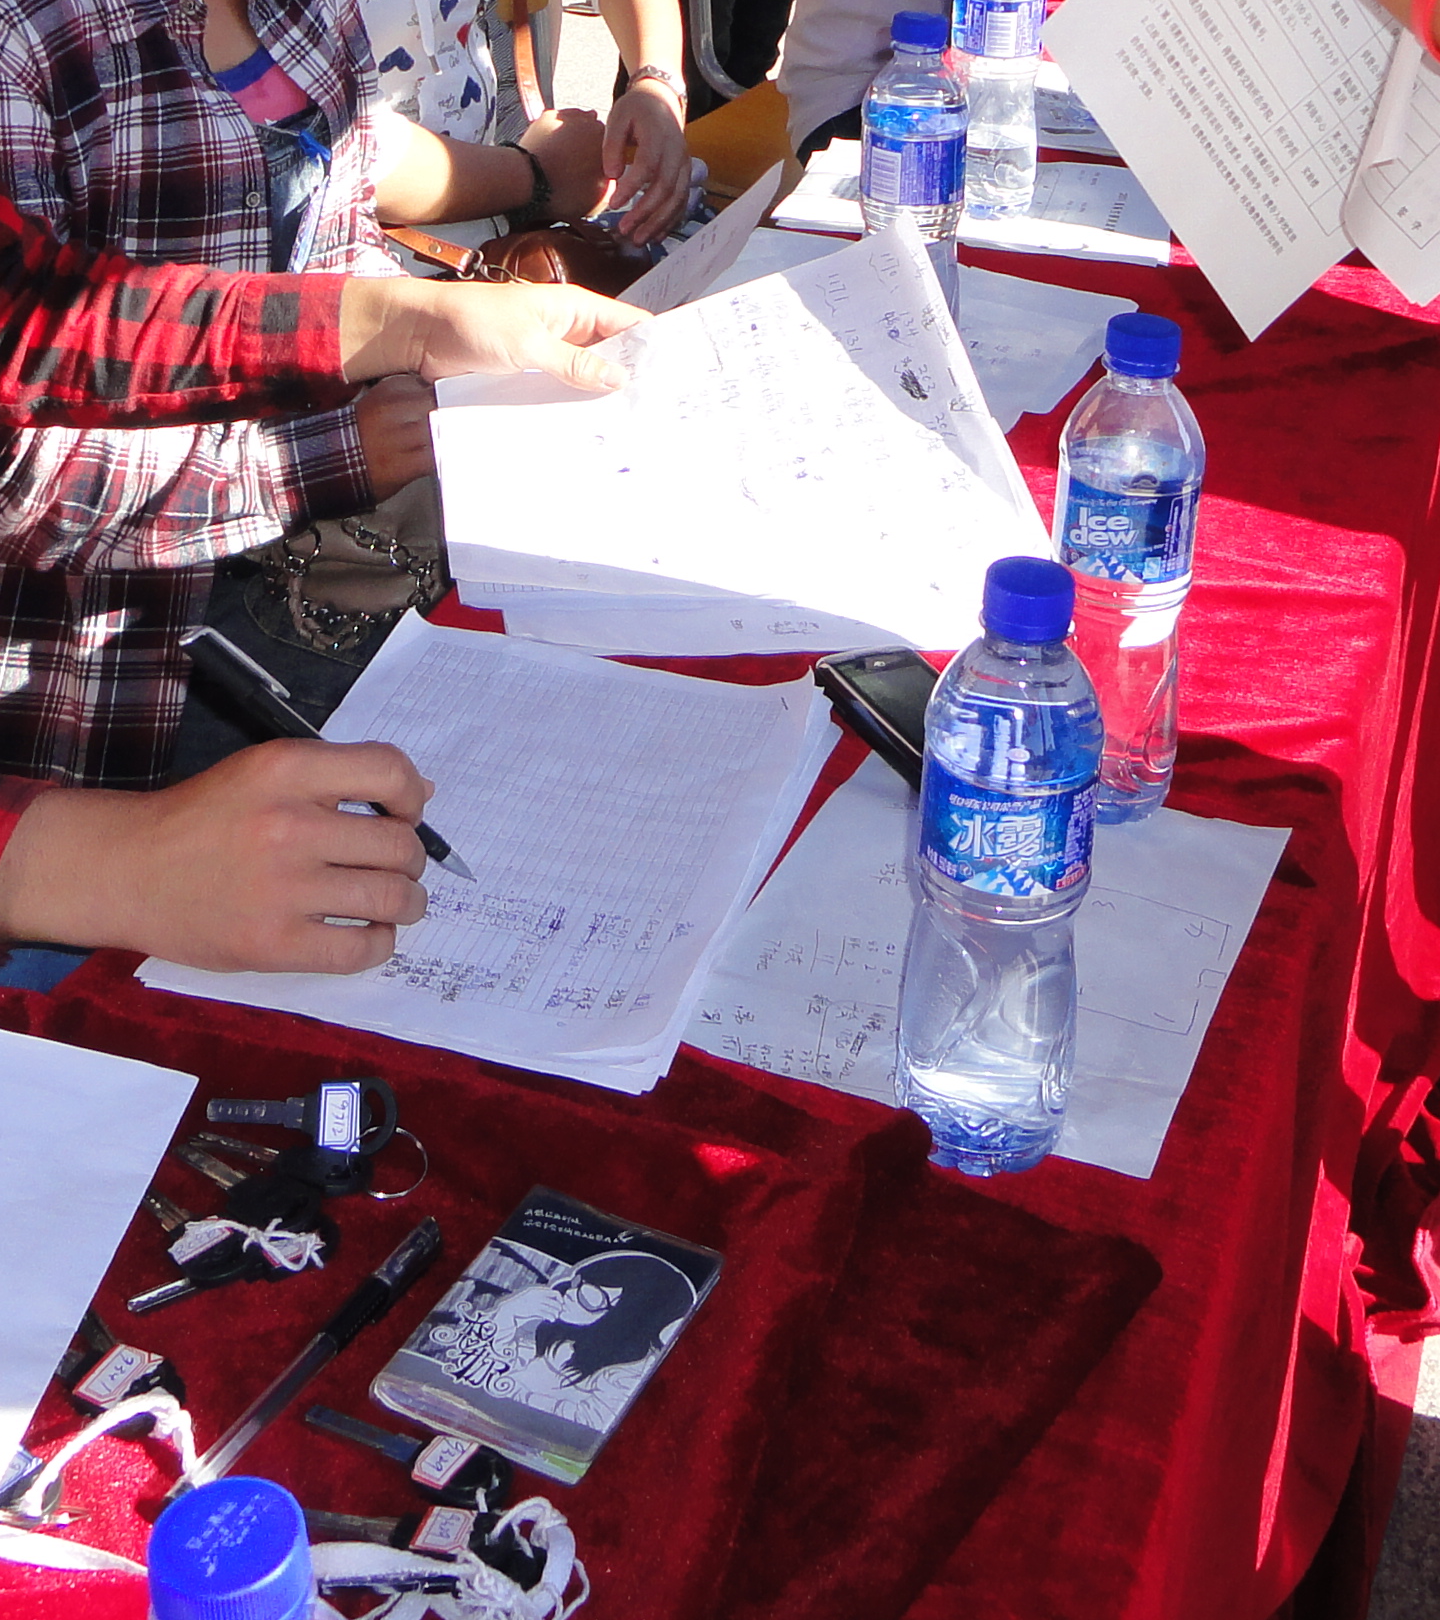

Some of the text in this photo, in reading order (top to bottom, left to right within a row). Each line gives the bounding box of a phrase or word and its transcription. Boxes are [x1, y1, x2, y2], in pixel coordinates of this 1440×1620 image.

[1078, 506, 1131, 531] Ice
[1069, 526, 1137, 548] dew
[947, 812, 1045, 860] 冰露
